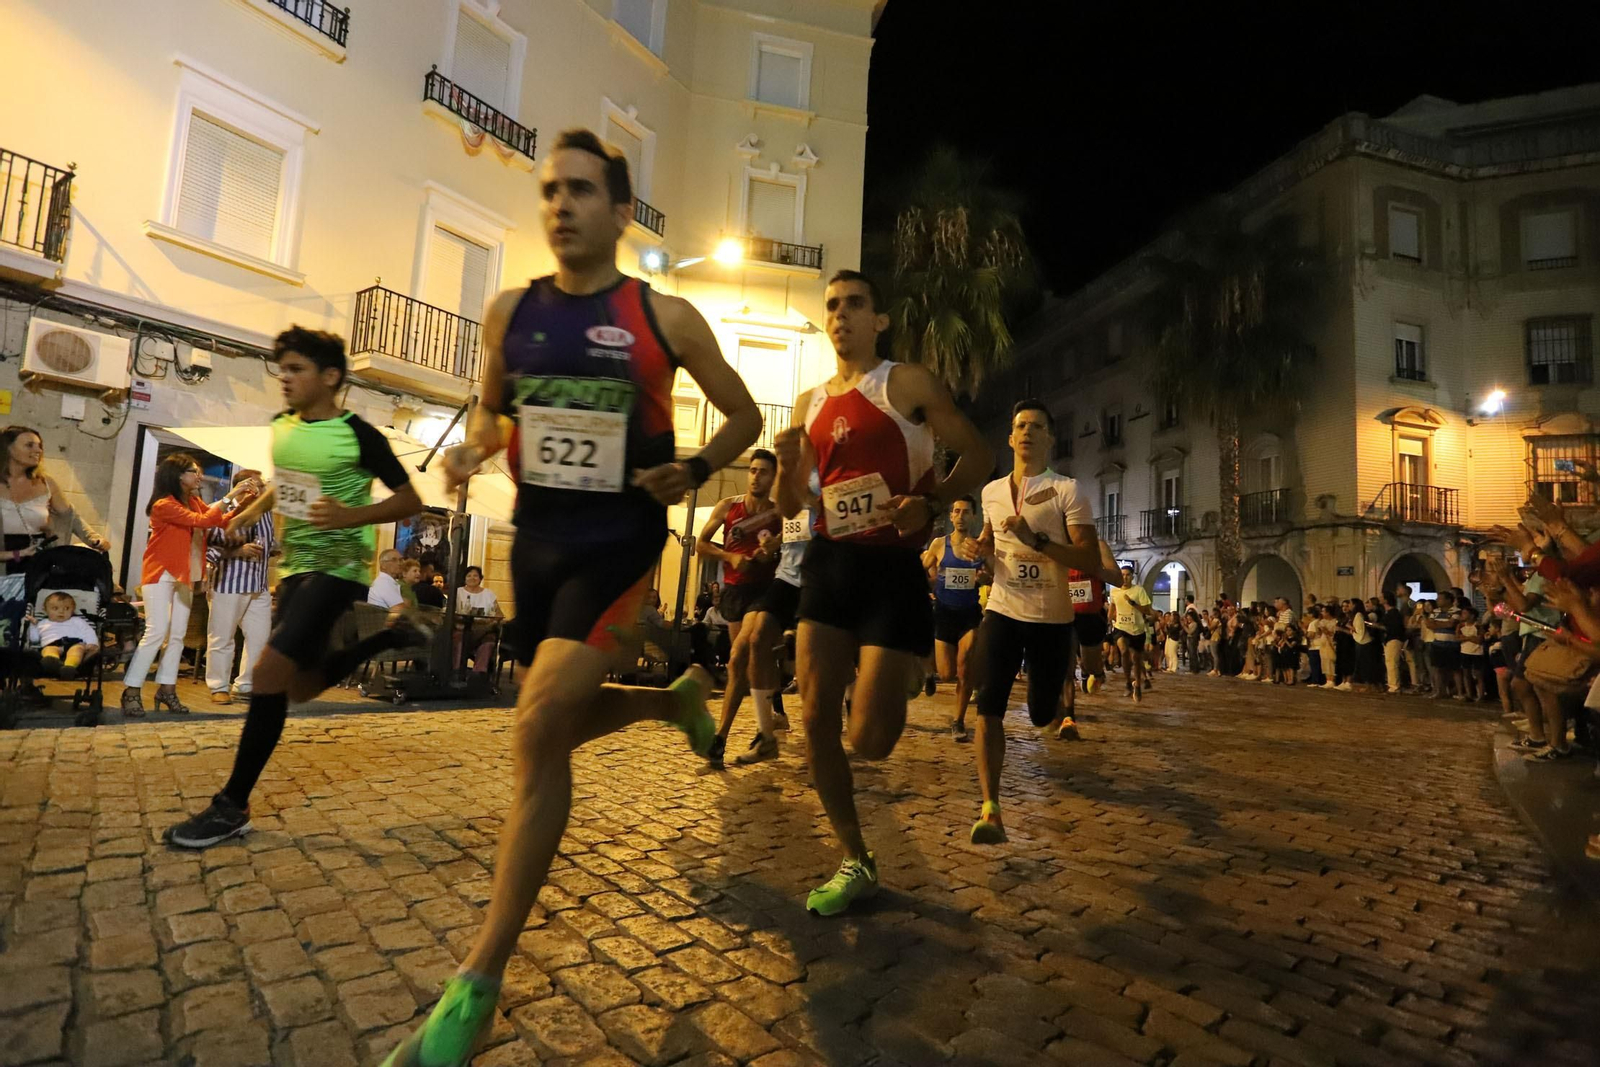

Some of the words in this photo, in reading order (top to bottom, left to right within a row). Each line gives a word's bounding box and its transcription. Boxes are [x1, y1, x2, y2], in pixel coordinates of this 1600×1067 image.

[539, 436, 598, 468] 622
[836, 493, 873, 520] 947
[952, 575, 970, 584] 205
[1018, 564, 1040, 579] 30
